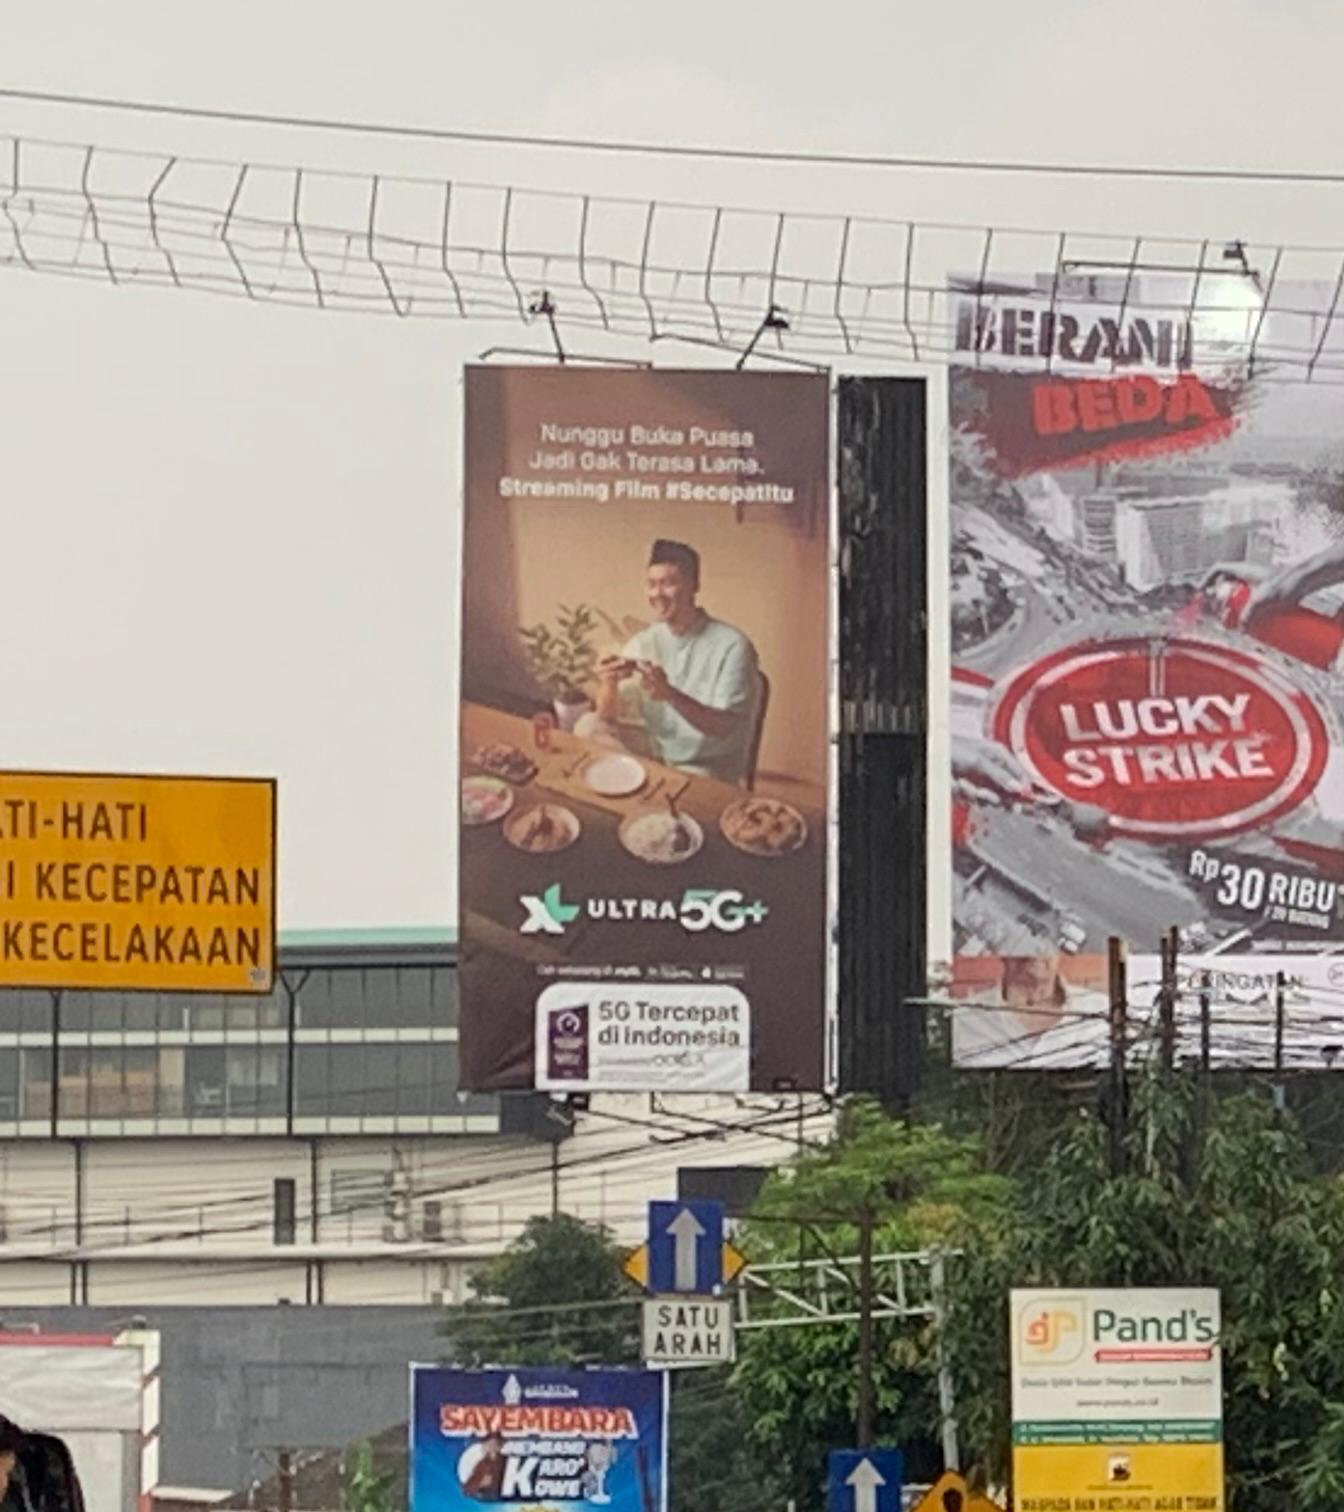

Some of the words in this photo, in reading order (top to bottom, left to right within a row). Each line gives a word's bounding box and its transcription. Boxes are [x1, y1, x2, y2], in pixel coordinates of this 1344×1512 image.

[956, 306, 1192, 370] BERANI
[1033, 373, 1217, 434] BEDA
[541, 425, 624, 447] Nunggu
[631, 426, 684, 445] Buka
[690, 427, 754, 446] Puasa
[530, 451, 573, 470] Jadi
[581, 452, 621, 470] Gak
[627, 452, 694, 472] Terasa
[500, 478, 609, 501] Streaming
[615, 480, 660, 499] Film
[1060, 693, 1250, 741] LUCKY
[1062, 737, 1274, 788] STRIKE
[0, 800, 147, 841] TI-HATI
[36, 861, 259, 905] KECEPATAN
[520, 883, 580, 933] XL
[587, 899, 677, 920] ULTRA
[4, 920, 260, 966] KECELAKAAN
[598, 1001, 630, 1021] 5G
[637, 1001, 740, 1024] Tercepat
[598, 1026, 619, 1045] di
[624, 1026, 741, 1047] Indonesia
[658, 1306, 719, 1327] SATU
[1094, 1309, 1213, 1343] Pand's
[654, 1332, 721, 1356] ARAH
[441, 1402, 638, 1438] SAYEMBARA
